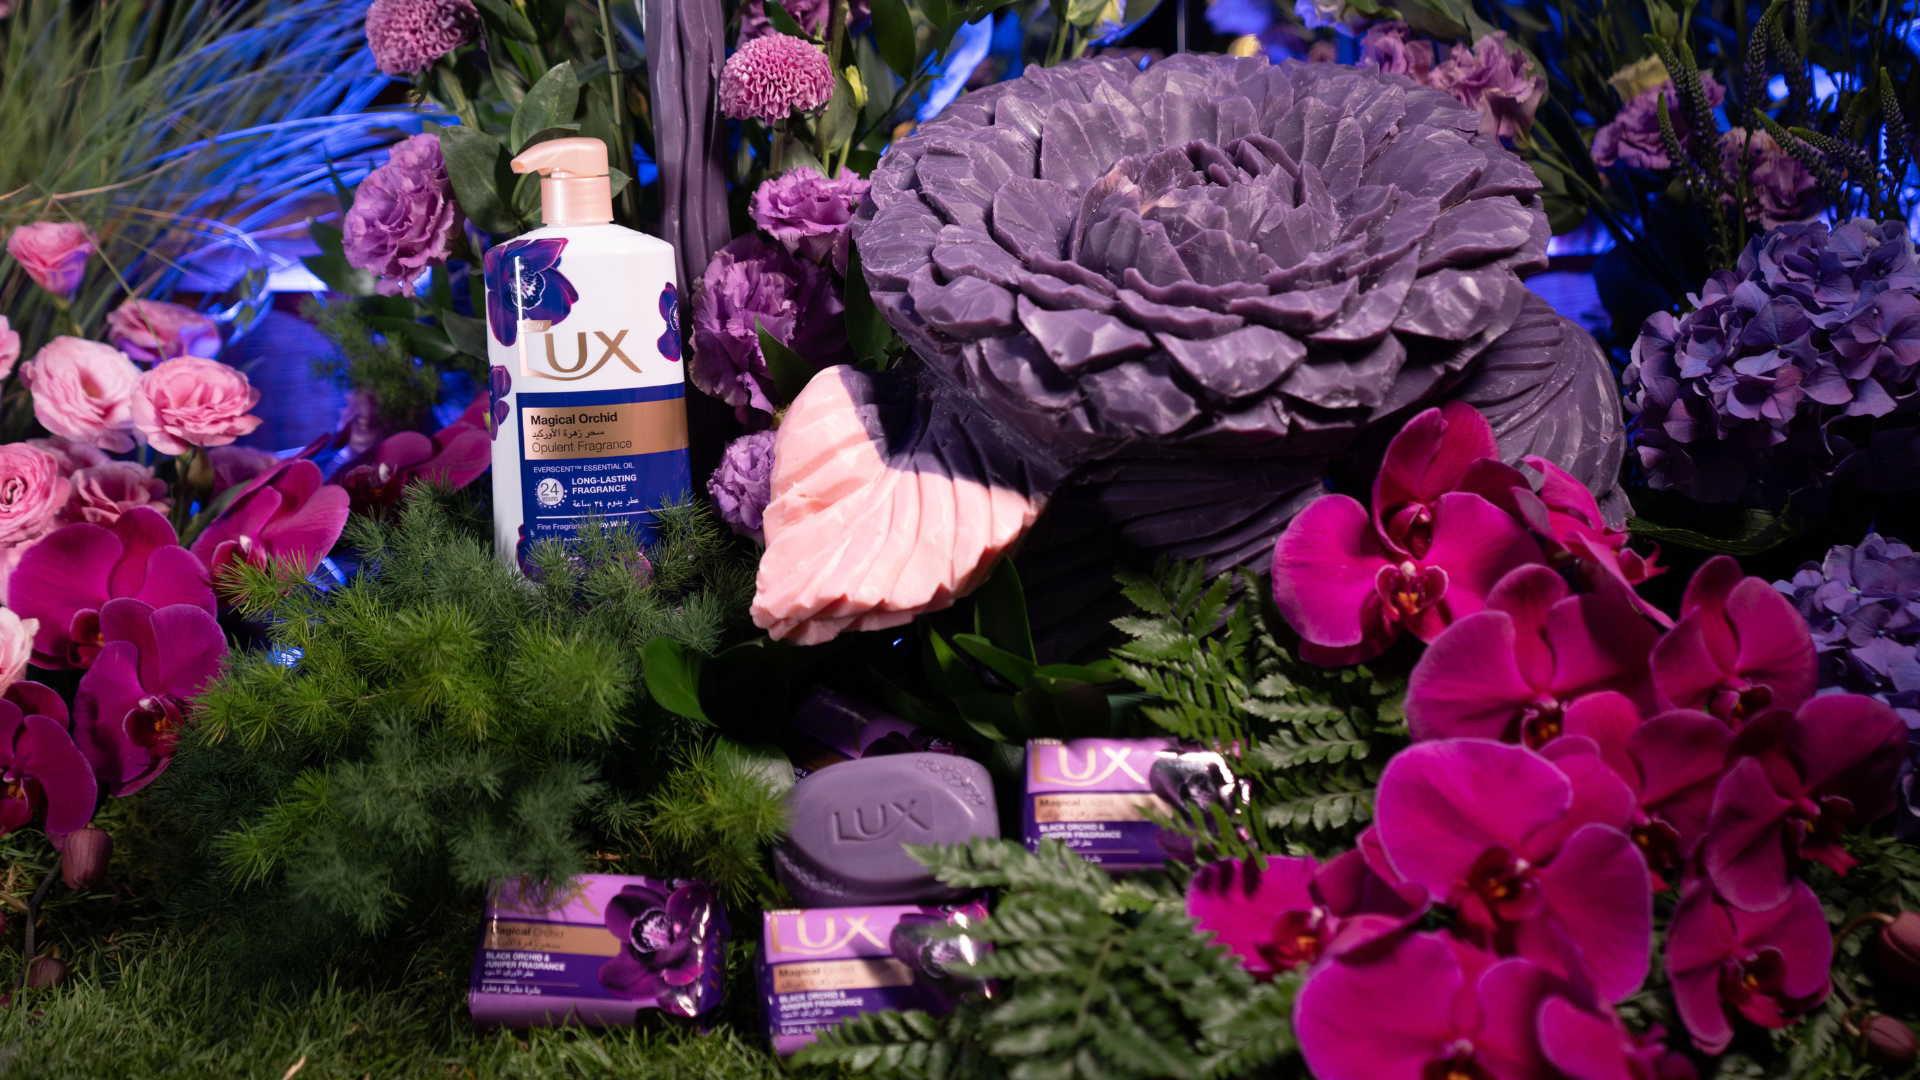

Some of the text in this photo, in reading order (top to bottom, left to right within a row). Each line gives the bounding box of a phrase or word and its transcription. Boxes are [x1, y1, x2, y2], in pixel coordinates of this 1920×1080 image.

[522, 322, 544, 330] NEW
[518, 329, 643, 381] LUX
[531, 412, 618, 427] Magical Orchid
[563, 428, 583, 439] زهرة
[585, 430, 604, 438] سحر
[532, 439, 632, 454] Opulent Fragrance
[583, 462, 622, 472] ESSENTIAL
[623, 462, 634, 470] OIL
[572, 474, 637, 485] LONG-LASTING
[540, 482, 559, 496] 24
[572, 485, 627, 494] FRAGRANCE
[607, 500, 622, 509] يدوم
[626, 496, 640, 506] عطر
[552, 523, 588, 531] Fragra
[1034, 738, 1063, 746] NEW
[1033, 747, 1146, 786] LUX
[1040, 799, 1080, 808] Magical
[832, 799, 931, 844] LUX
[1039, 824, 1066, 832] BLACK
[1066, 822, 1098, 831] ORCHID
[1040, 830, 1122, 840] NIPER FRAGRANCE
[533, 929, 564, 938] Orchid
[770, 914, 886, 955] LUX
[486, 952, 550, 962] BLACK ORCHID &
[484, 960, 566, 972] JUNIPER FRAGRANCE
[778, 968, 820, 978] Magical
[778, 993, 806, 1004] BLACK
[806, 991, 838, 1000] ORCHID
[779, 997, 864, 1012] JUNIPER FRAGRANCE
